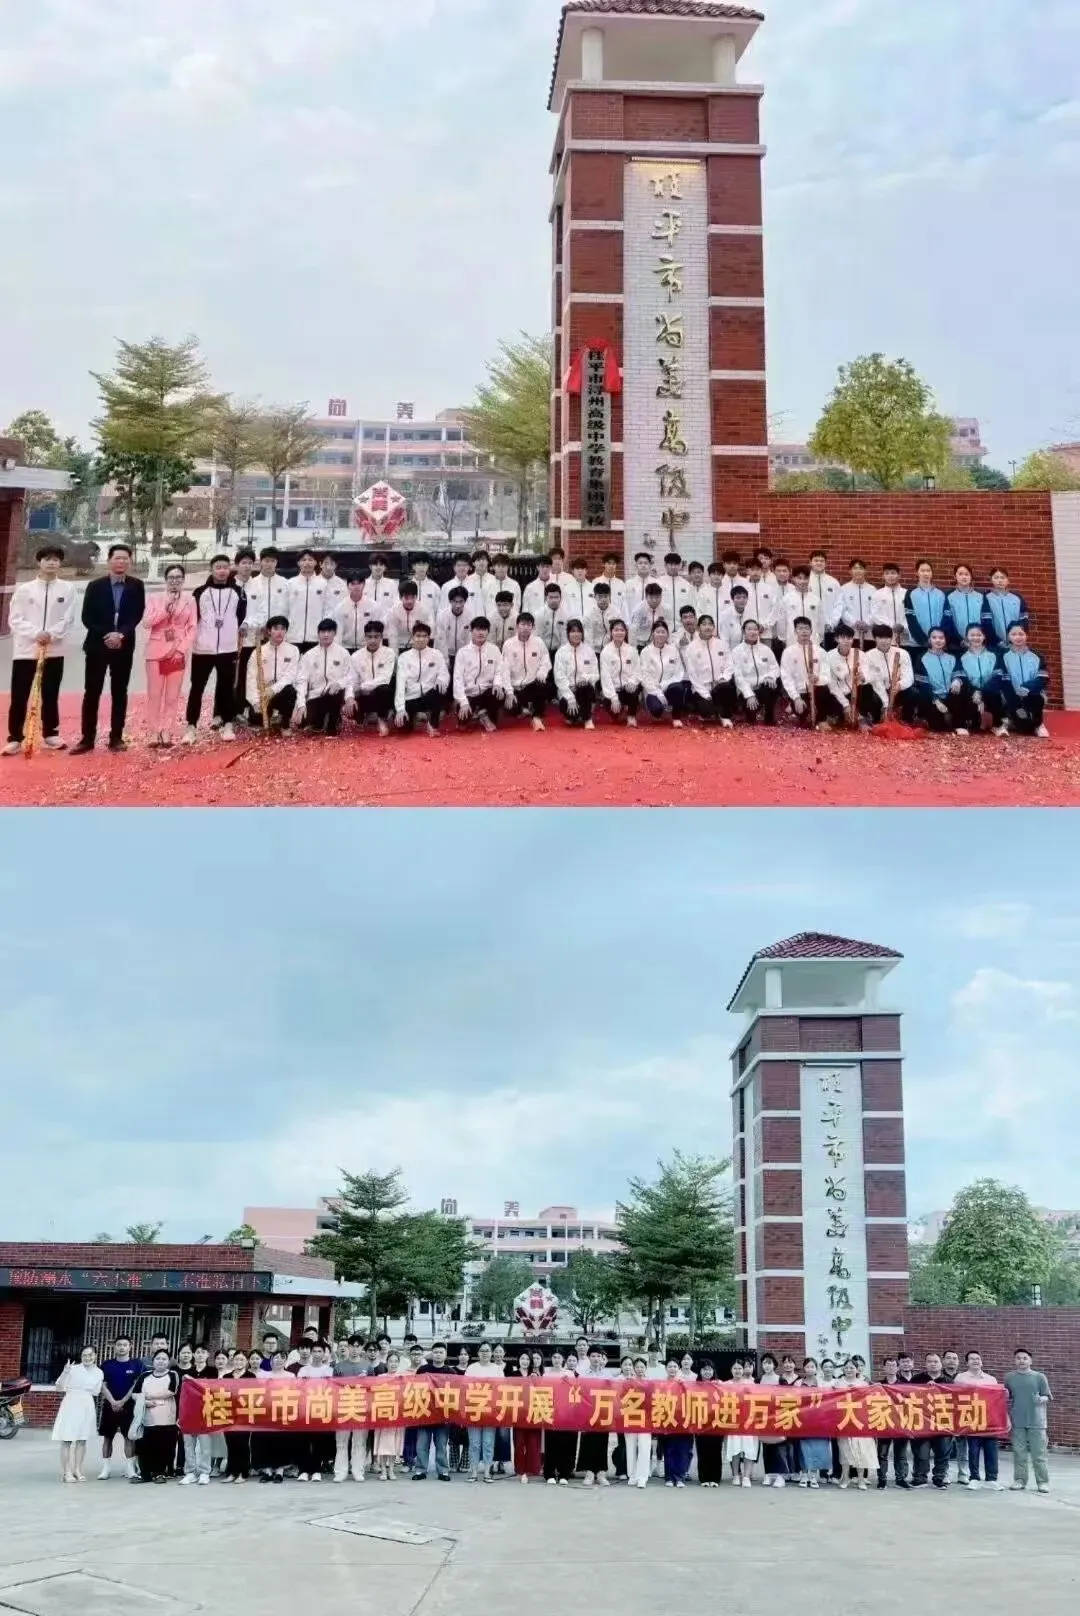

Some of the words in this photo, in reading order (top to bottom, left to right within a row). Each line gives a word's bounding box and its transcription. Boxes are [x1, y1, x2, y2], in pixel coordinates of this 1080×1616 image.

[202, 1381, 988, 1432] 桂平市尚美高级中学开展“万名教师进万家”大家访活动
